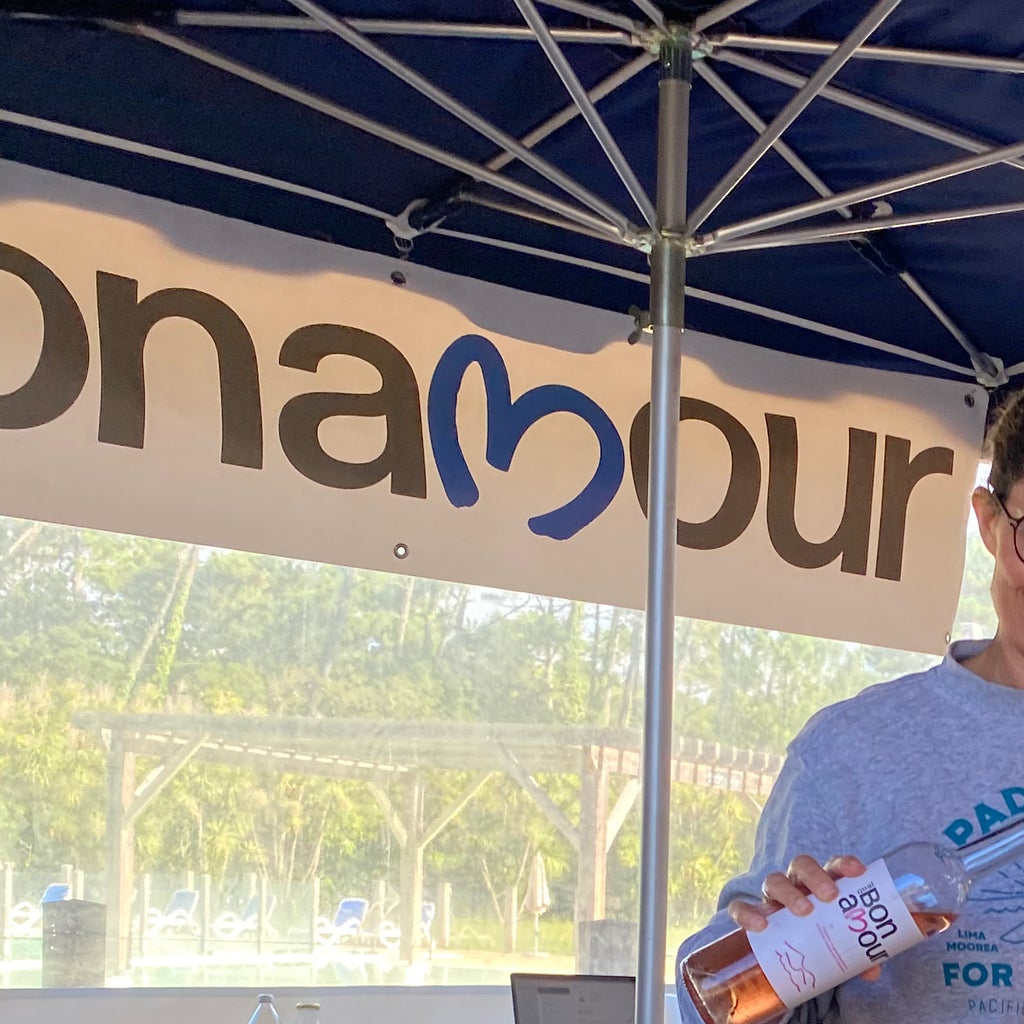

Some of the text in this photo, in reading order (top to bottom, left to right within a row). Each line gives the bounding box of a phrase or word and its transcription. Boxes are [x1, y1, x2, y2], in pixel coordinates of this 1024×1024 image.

[838, 894, 889, 962] amour
[957, 929, 986, 941] LIMA
[946, 942, 999, 953] MOOREA
[943, 962, 1014, 988] FOR
